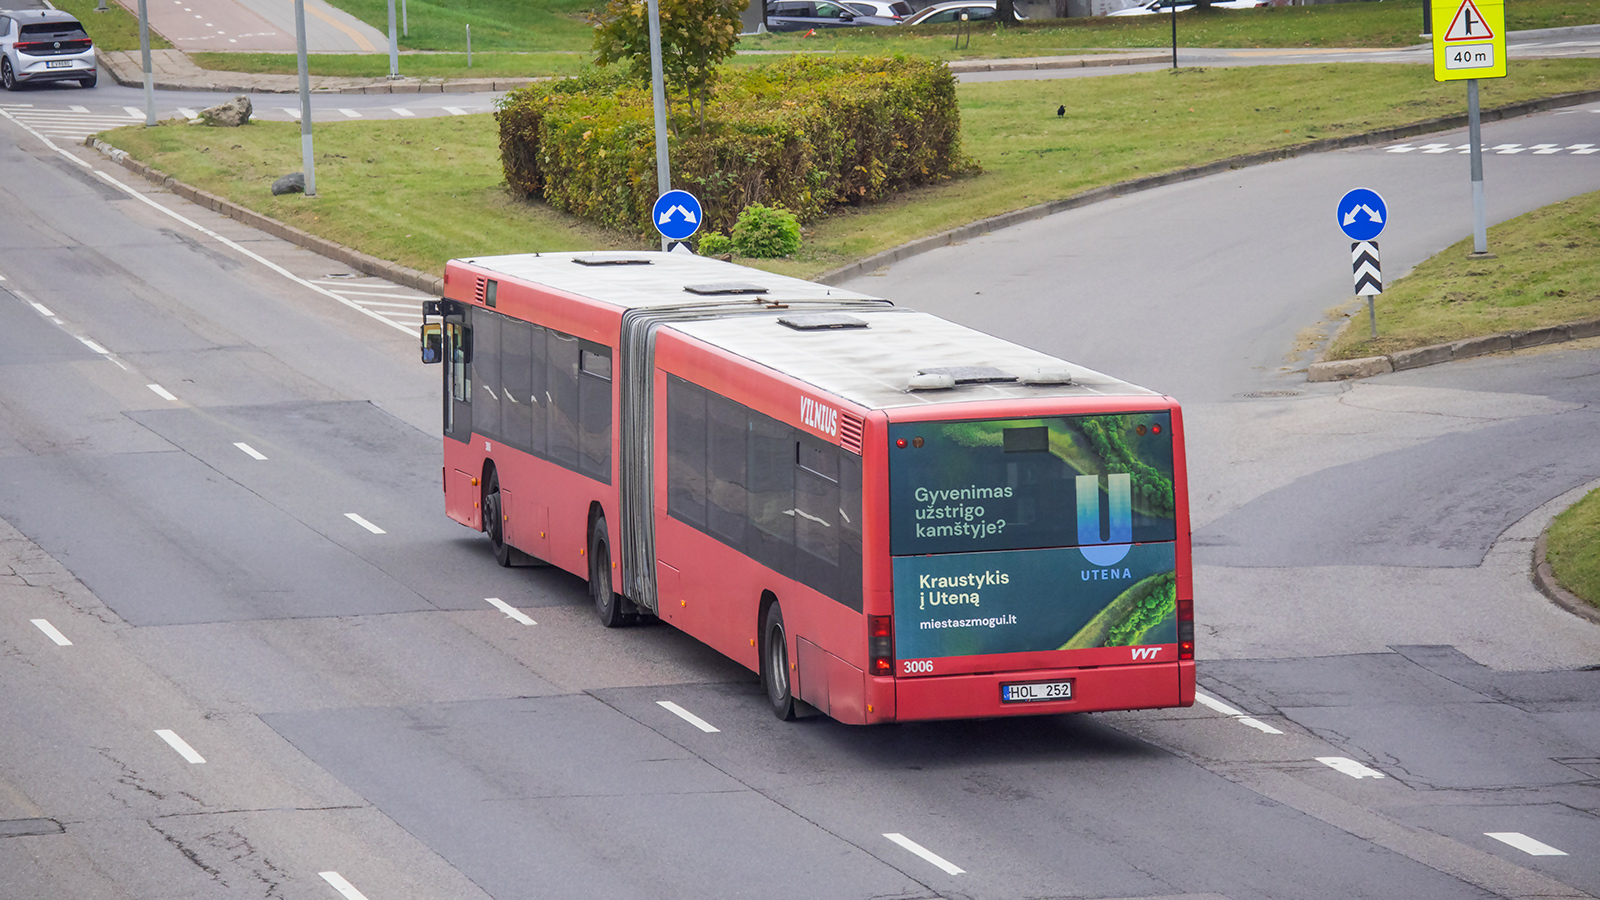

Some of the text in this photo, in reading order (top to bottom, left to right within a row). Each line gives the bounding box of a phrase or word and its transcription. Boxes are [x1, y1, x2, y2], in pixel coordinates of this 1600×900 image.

[1454, 51, 1486, 62] 40 m
[801, 395, 837, 437] VILNIUS
[915, 484, 1013, 505] Gyvenimas
[915, 503, 985, 522] užstrigo
[916, 519, 1006, 539] kamštyje?
[919, 570, 1010, 590] Kraustykis
[1081, 568, 1132, 581] UTENA
[919, 591, 980, 610] į Uteną
[920, 614, 1017, 629] miestaszmogui.lt
[1131, 647, 1162, 660] VVT
[904, 660, 934, 673] 3006
[1010, 684, 1069, 699] HOL 252
